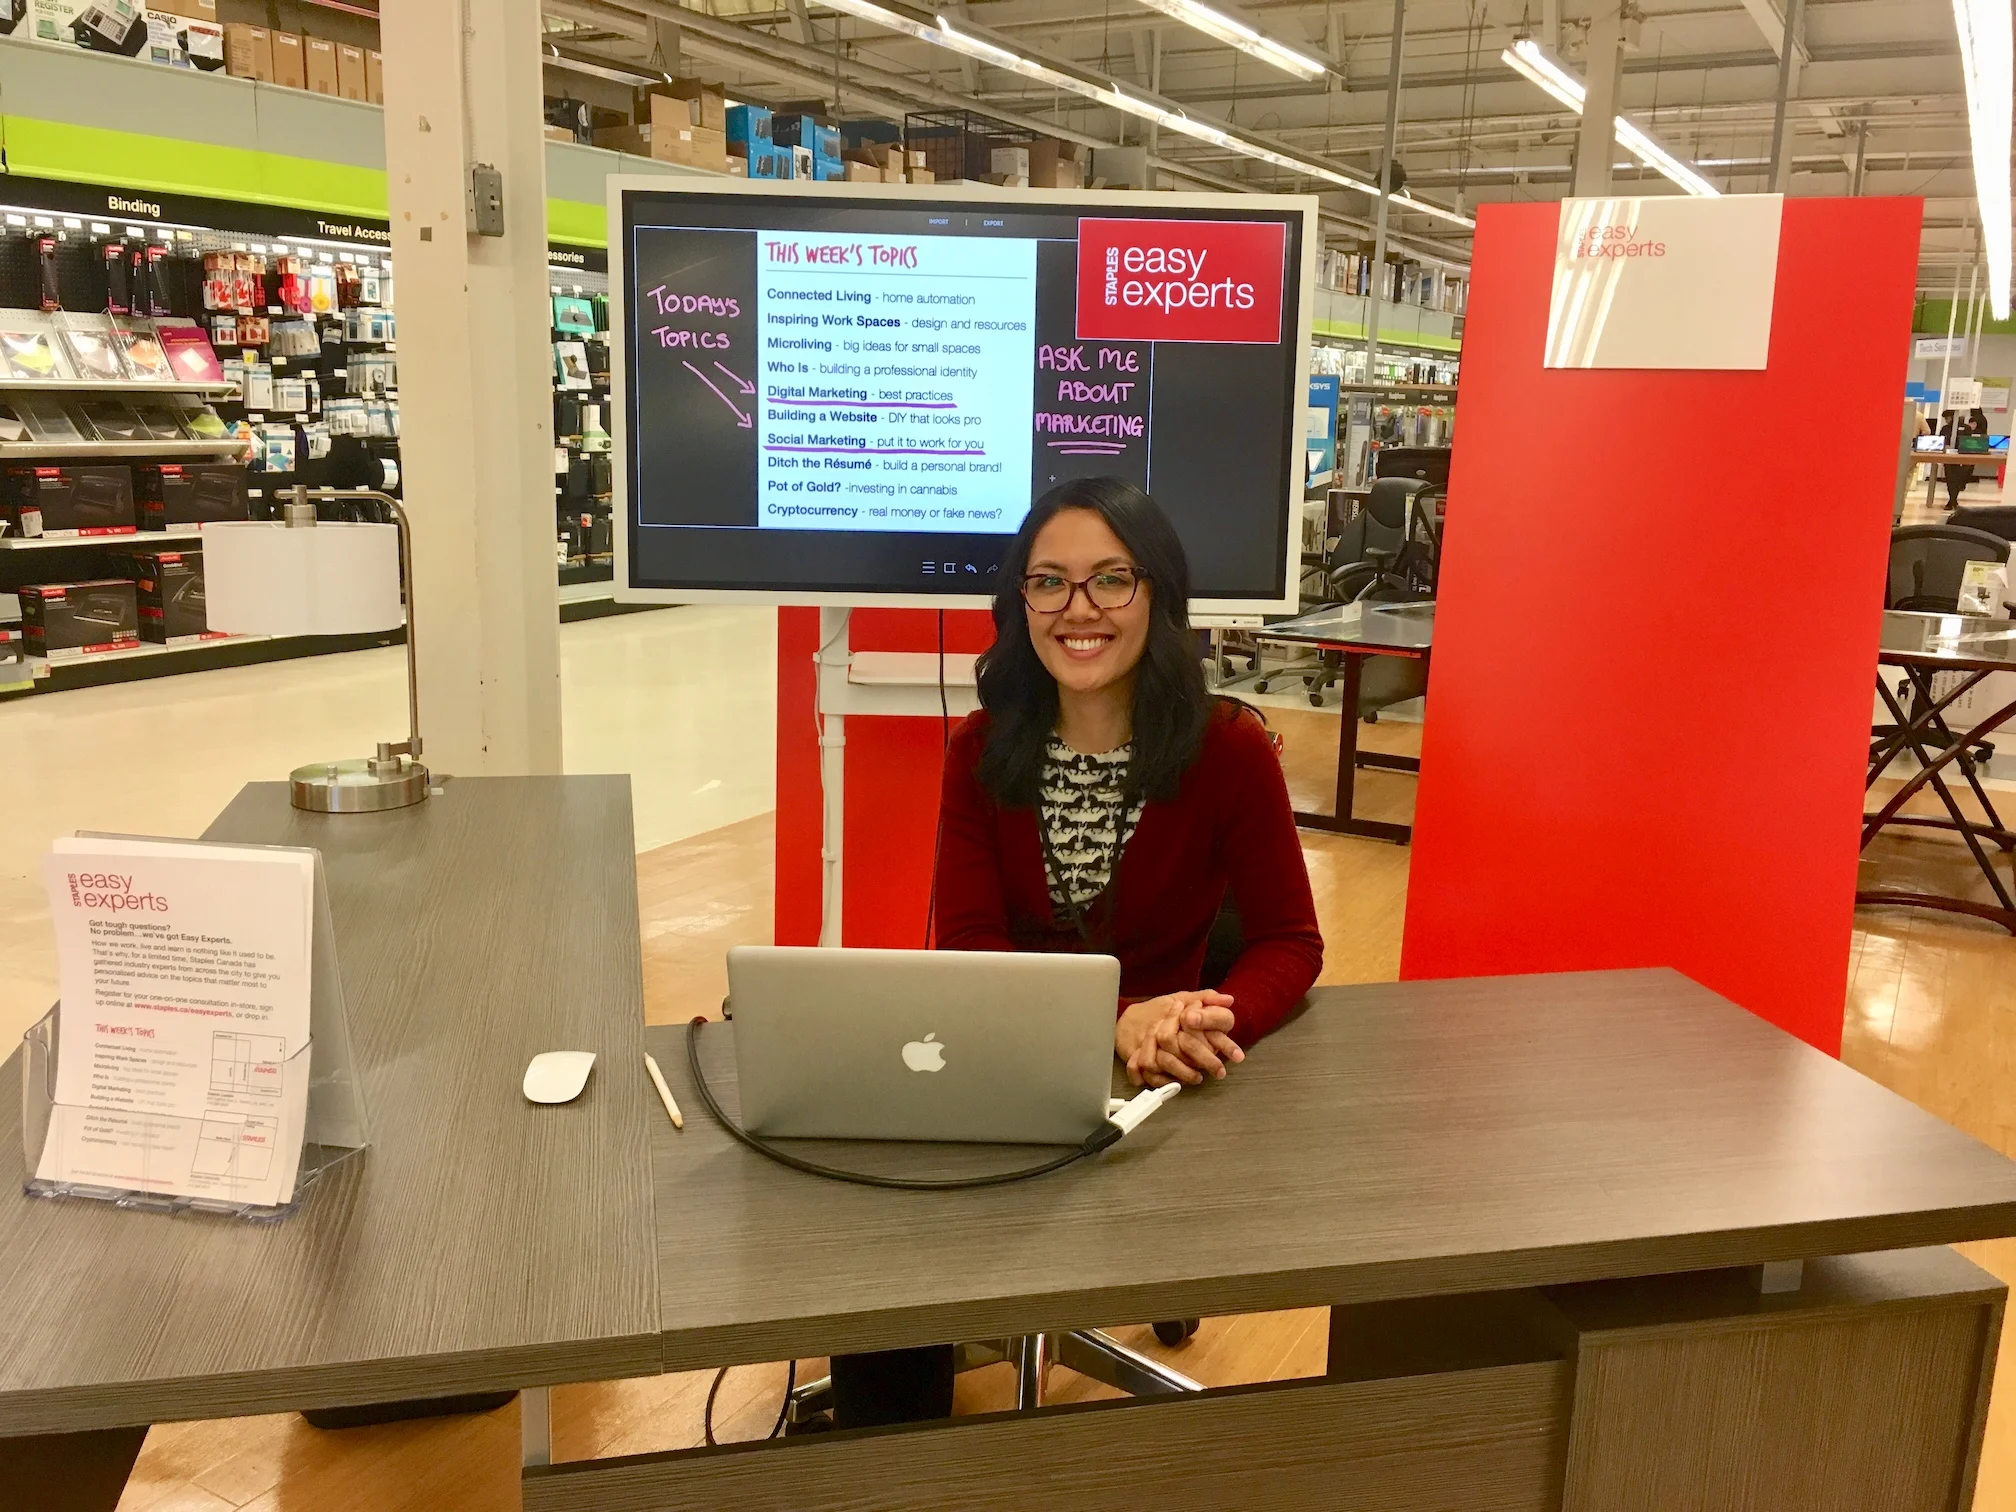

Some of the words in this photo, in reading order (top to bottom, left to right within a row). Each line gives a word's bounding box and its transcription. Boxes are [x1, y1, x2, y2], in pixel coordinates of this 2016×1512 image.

[147, 12, 176, 23] CASIO
[108, 196, 160, 217] Binding
[317, 220, 352, 236] Travel
[1589, 225, 1638, 243] easy
[765, 241, 799, 264] THIS
[805, 244, 863, 267] WEEK'S
[868, 245, 918, 269] TOPICS
[1587, 240, 1666, 261] experts
[1123, 246, 1207, 282] easy
[1105, 246, 1119, 306] STAPLES
[647, 285, 741, 318] TODAY'S
[767, 288, 832, 301] Connected
[836, 290, 871, 305] Living
[883, 292, 913, 304] home
[917, 293, 975, 306] automation
[1122, 276, 1255, 315] experts
[767, 313, 819, 327] Inspiring
[822, 314, 853, 326] Work
[857, 315, 900, 328] Spaces
[912, 317, 947, 330] design
[951, 319, 971, 330] and
[974, 320, 1027, 332] resources
[651, 326, 730, 349] TOPICS
[768, 337, 832, 352] Microliving
[843, 339, 860, 353] big
[863, 340, 891, 352] ideas
[895, 341, 908, 352] for
[912, 341, 939, 353] small
[942, 343, 981, 355] spaces
[1038, 344, 1091, 372] ASK
[1099, 347, 1140, 372] ME
[768, 361, 795, 373] Who
[798, 362, 808, 373] Is
[820, 363, 861, 376] building
[864, 366, 871, 375] a
[874, 364, 937, 378] professional
[940, 365, 978, 379] identity
[768, 385, 805, 400] Digital
[808, 387, 867, 401] Marketing
[879, 389, 902, 400] best
[905, 390, 953, 402] practices
[1057, 380, 1135, 404] ABOUT
[768, 409, 816, 423] Building
[820, 412, 826, 421] a
[830, 411, 877, 423] Website
[889, 412, 907, 424] DIY
[910, 413, 930, 424] that
[933, 414, 961, 425] looks
[964, 416, 982, 427] pro
[1035, 412, 1145, 438] MARKETING
[768, 433, 804, 446] Social
[807, 435, 866, 448] Marketing
[877, 437, 894, 449] put
[898, 437, 904, 448] it
[906, 438, 916, 448] to
[919, 438, 945, 449] work
[948, 438, 961, 449] for
[965, 439, 984, 451] you
[768, 457, 799, 469] Ditch
[802, 458, 820, 469] the
[824, 457, 872, 470] Résumé
[883, 460, 907, 472] build
[911, 462, 918, 472] a
[921, 461, 966, 473] personal
[969, 461, 1002, 473] brand!
[768, 481, 788, 492] Pot
[792, 481, 803, 492] of
[807, 481, 841, 493] Gold?
[845, 483, 895, 496] -investing
[898, 484, 907, 494] in
[910, 483, 958, 495] cannabis
[768, 504, 858, 518] Cryptocurrency
[869, 506, 887, 517] real
[891, 508, 926, 520] money
[929, 509, 940, 519] or
[943, 507, 965, 518] fake
[968, 507, 1003, 520] news?
[68, 873, 81, 907] STAPLES
[80, 873, 132, 894] easy
[84, 892, 168, 913] experts
[89, 919, 103, 927] Got
[105, 921, 127, 929] tough
[181, 933, 199, 943] Easy
[92, 948, 113, 956] That's
[190, 956, 214, 964] Staples
[217, 958, 242, 966] Canada
[193, 948, 218, 956] nothing
[124, 961, 150, 969] industry
[94, 968, 135, 977] personalized
[183, 975, 202, 983] topics
[96, 988, 121, 997] Register
[150, 995, 188, 1003] one-on-one
[189, 998, 229, 1007] consultation
[245, 1012, 260, 1020] drop
